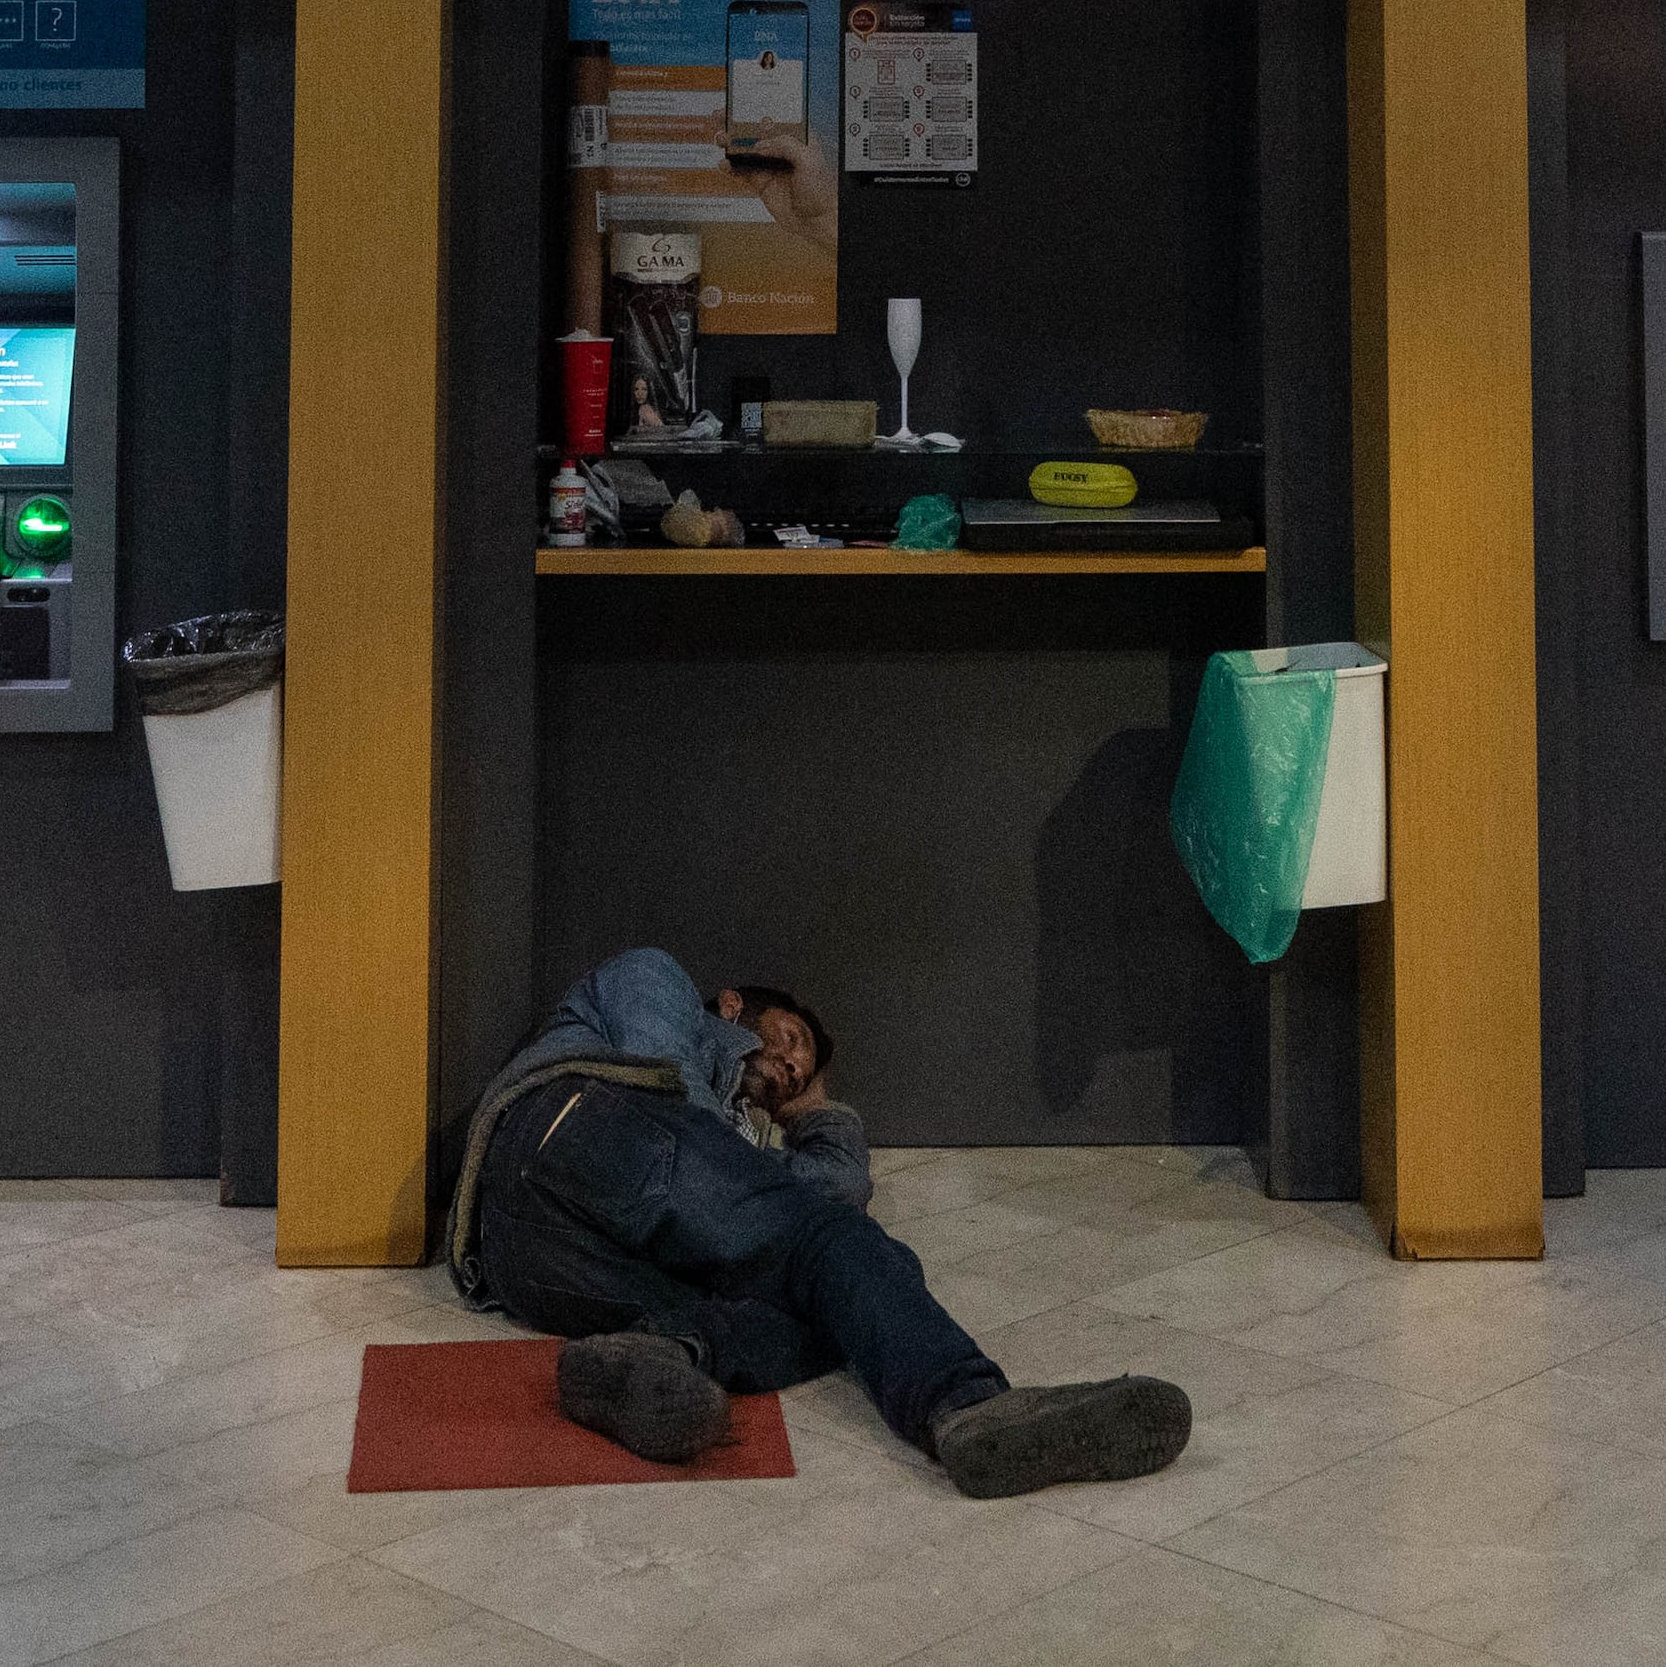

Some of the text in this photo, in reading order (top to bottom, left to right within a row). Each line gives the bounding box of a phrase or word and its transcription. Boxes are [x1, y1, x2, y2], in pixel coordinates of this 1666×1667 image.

[0, 80, 18, 91] no
[23, 77, 83, 91] clientes
[727, 291, 766, 304] Banco
